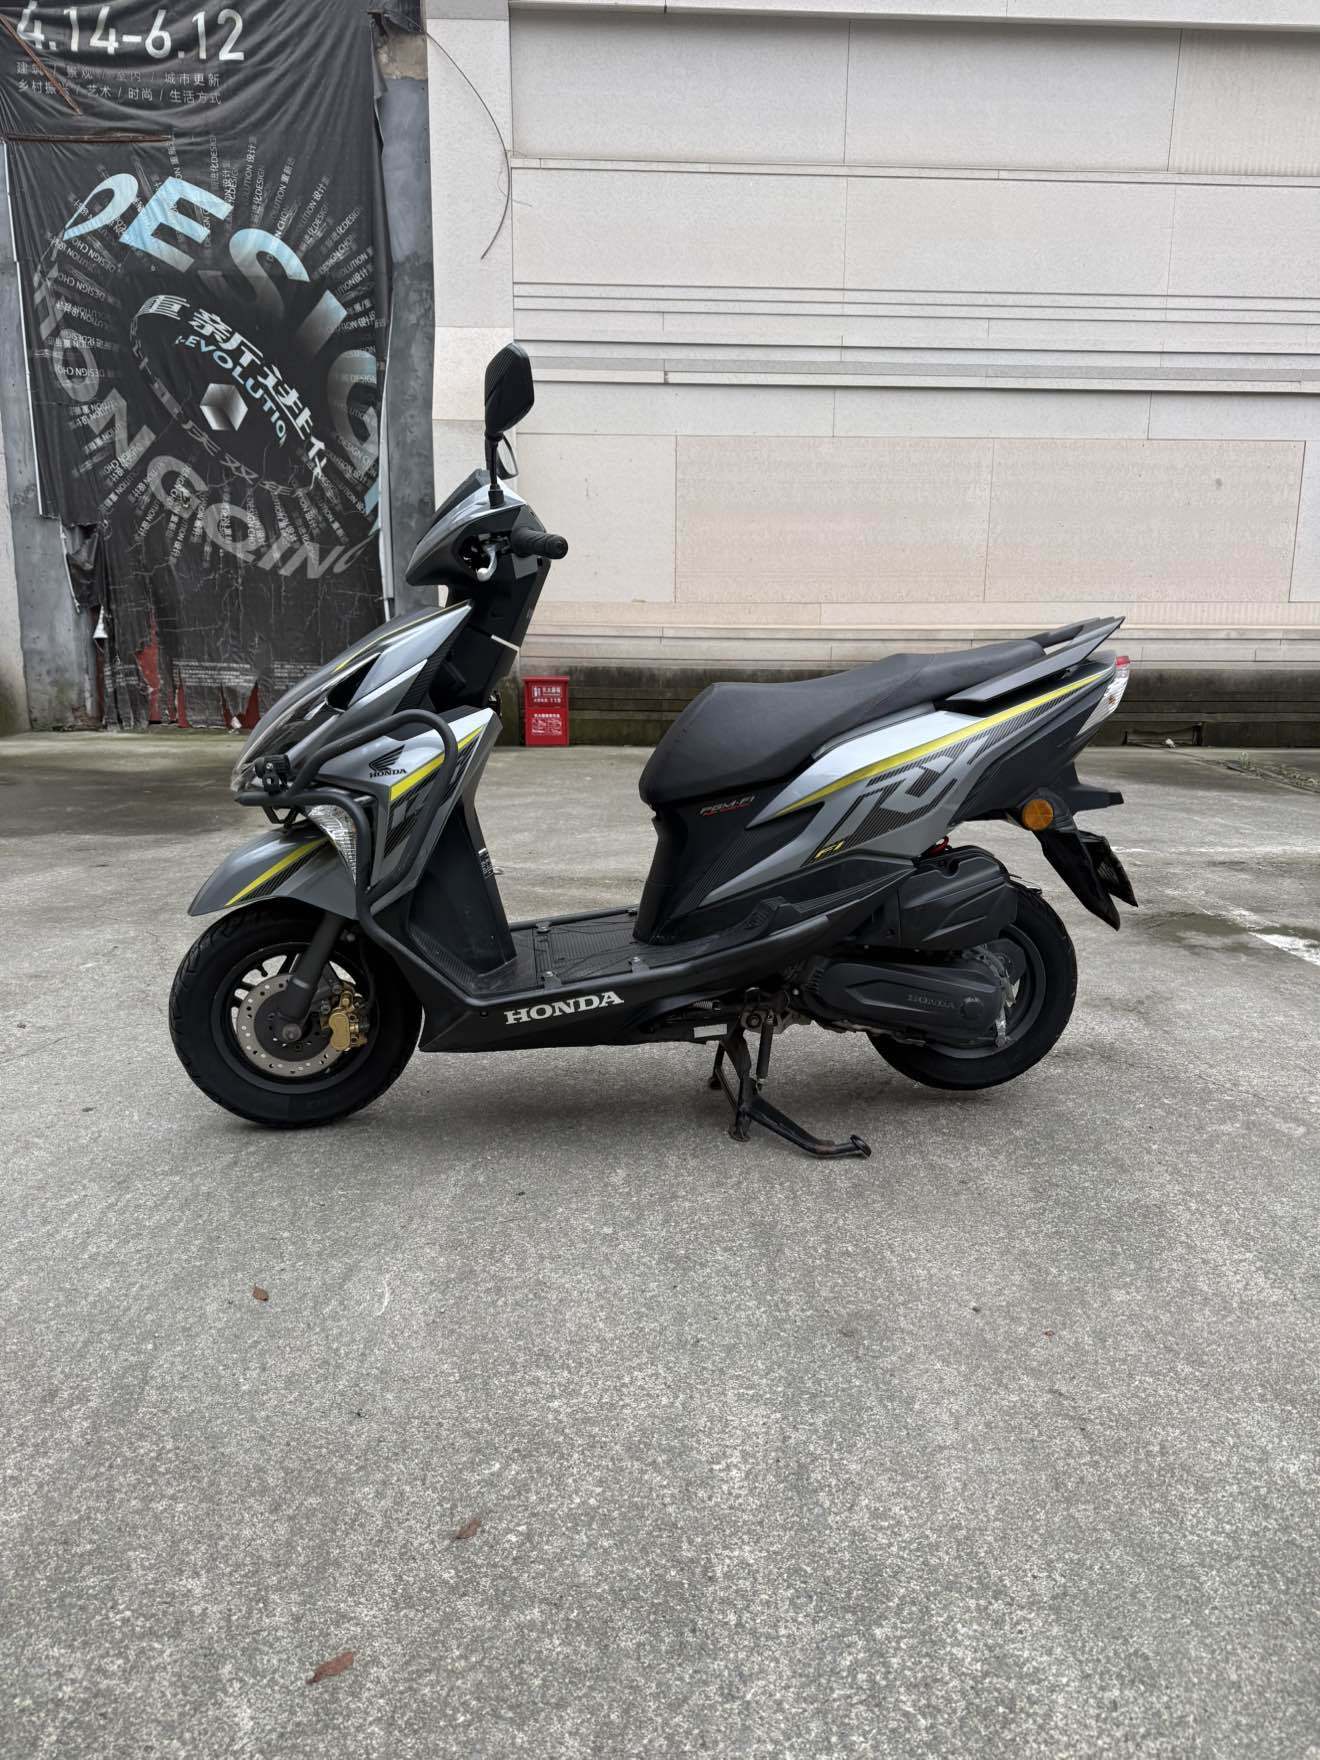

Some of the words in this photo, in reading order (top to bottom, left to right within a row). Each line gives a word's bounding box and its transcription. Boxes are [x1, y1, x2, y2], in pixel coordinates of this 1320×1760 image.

[17, 0, 246, 62] 4.14-6.12
[164, 72, 222, 88] 城市更新
[87, 84, 112, 98] 艺术
[128, 87, 154, 102] 时尚
[169, 89, 223, 105] 生活方式
[369, 768, 407, 778] HONDA
[504, 991, 624, 1024] HONDA
